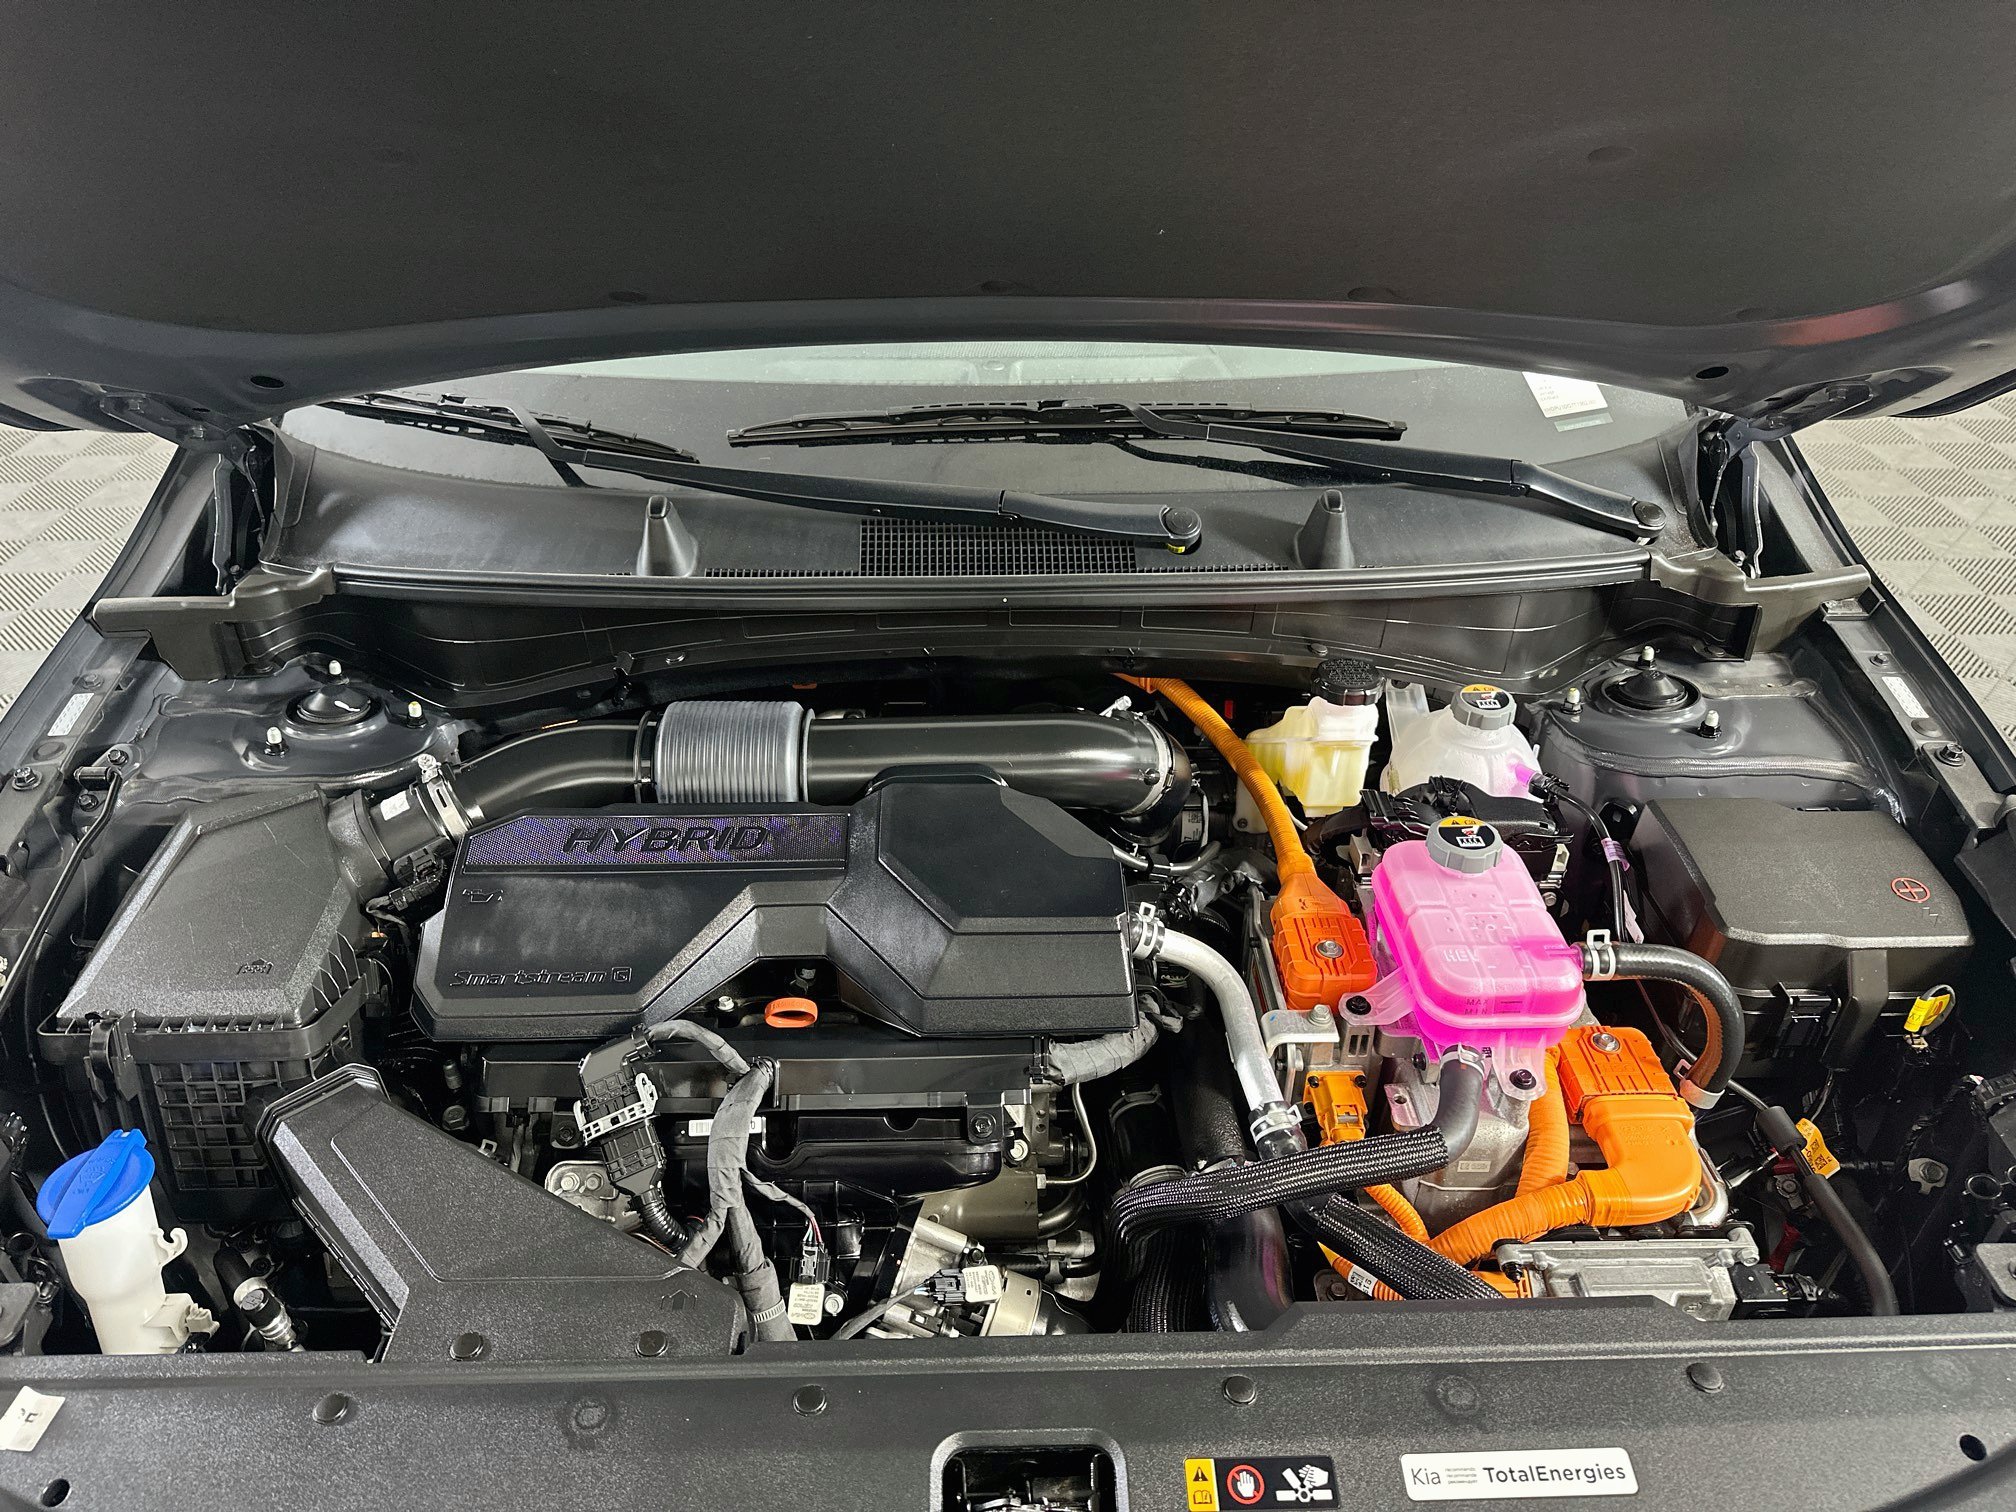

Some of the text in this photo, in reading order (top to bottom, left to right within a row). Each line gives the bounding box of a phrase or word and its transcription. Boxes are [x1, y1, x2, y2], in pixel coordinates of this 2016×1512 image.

[562, 826, 771, 853] HYBRID
[450, 968, 608, 987] Smartstream
[1464, 1008, 1488, 1016] MIN
[1411, 1464, 1626, 1485] Kia TotalEnergies
